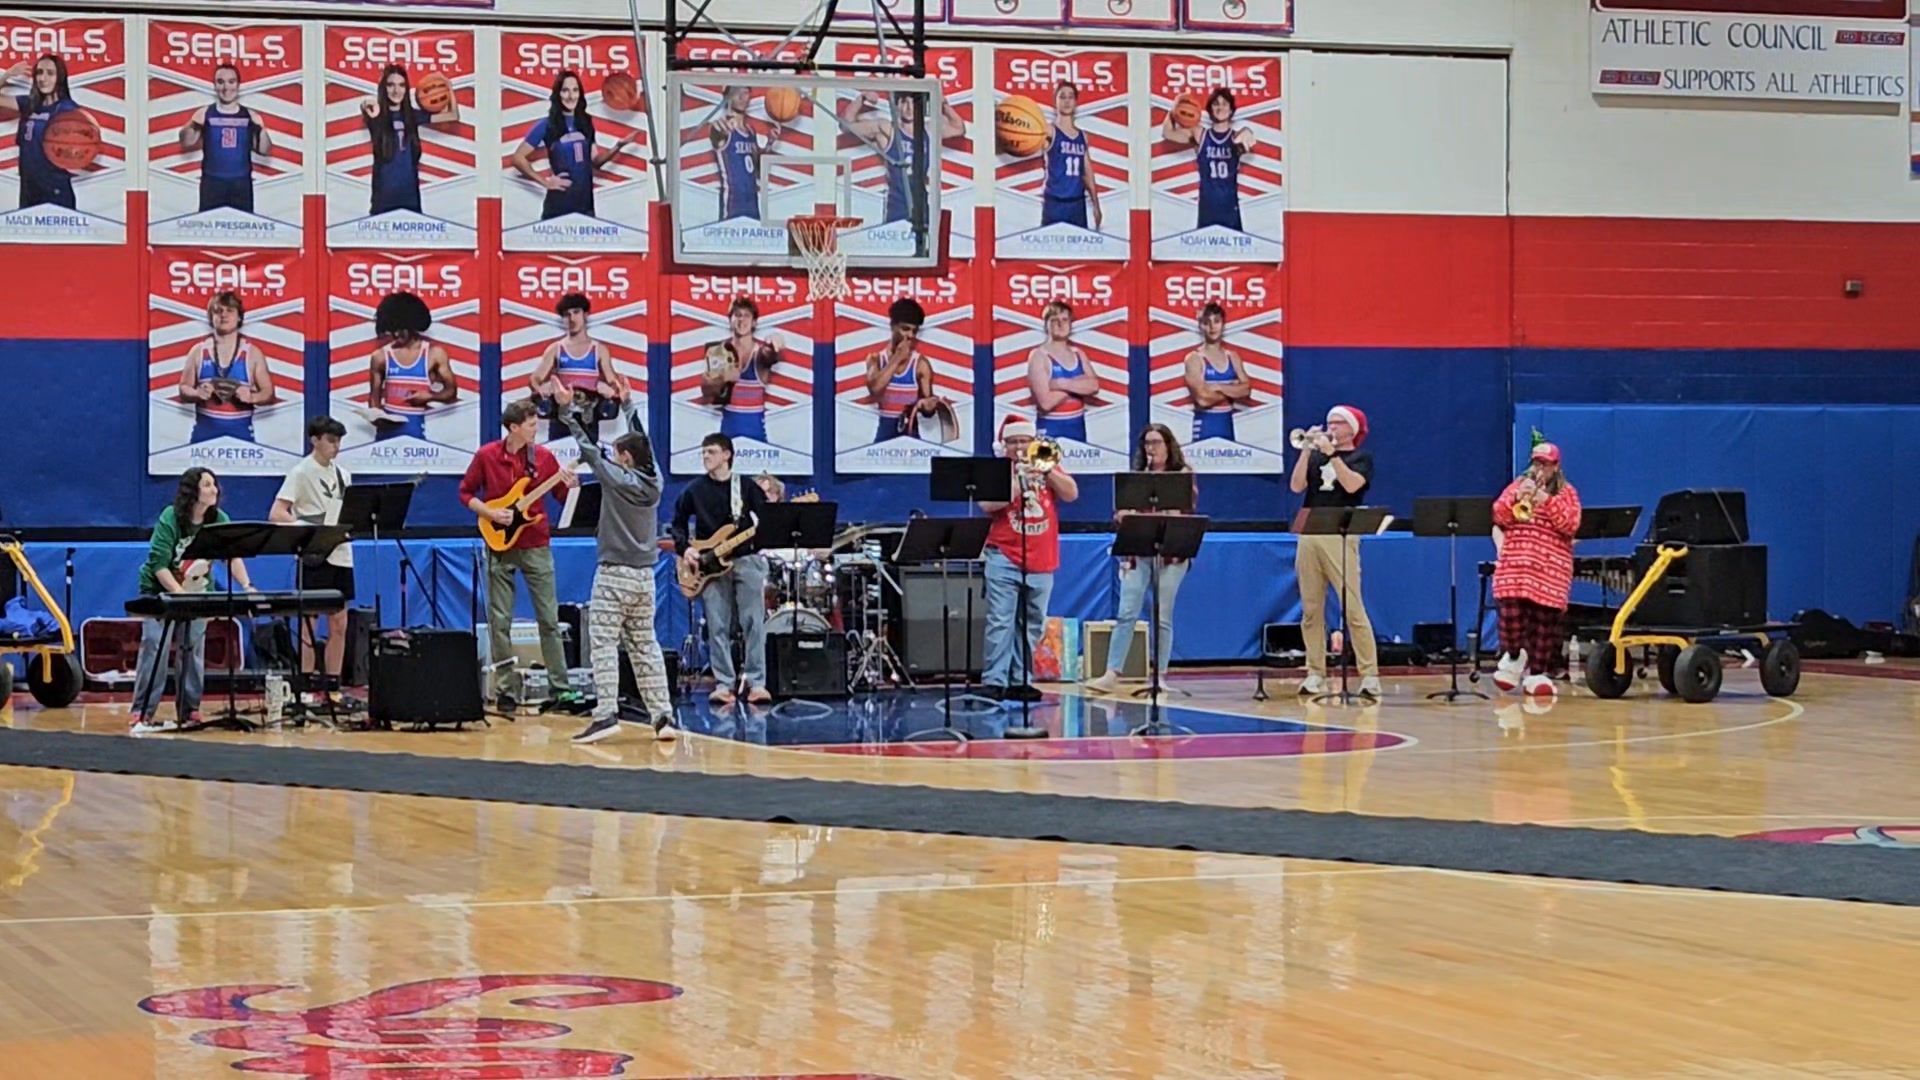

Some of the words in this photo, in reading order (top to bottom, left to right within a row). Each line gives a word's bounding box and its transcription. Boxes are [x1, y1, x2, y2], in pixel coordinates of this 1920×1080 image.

[1601, 18, 1711, 46] ATHLETIC
[1728, 22, 1828, 51] COUNCIL
[167, 31, 285, 60] SEALS
[343, 36, 458, 64] SEALS
[518, 43, 630, 70] SEALS
[1010, 59, 1113, 85] SEALS
[1165, 63, 1267, 89] SEALS
[1663, 69, 1756, 91] SUPPORTS
[1766, 72, 1799, 93] ALL
[1808, 74, 1905, 97] ATHLETICS
[1060, 141, 1085, 155] SEALS
[1205, 146, 1232, 159] SEALS
[744, 155, 754, 173] 0
[1065, 156, 1080, 176] 11
[1209, 160, 1229, 178] 10
[5, 215, 32, 225] MADI
[35, 216, 89, 226] MERRELL
[214, 221, 276, 231] PRESGRAVES
[357, 220, 390, 231] GRACE
[392, 221, 447, 232] MORRONE
[532, 225, 577, 235] MADALYN
[579, 226, 619, 236] BENNER
[703, 227, 739, 238] GRIFFIN
[741, 228, 784, 239] PARKER
[867, 230, 898, 241] CHASE
[1181, 235, 1208, 245] NOAH
[1209, 236, 1252, 246] WALTER
[168, 261, 287, 289] SEALS
[347, 263, 462, 289] SEALS
[517, 266, 630, 292] SEALS
[1009, 274, 1113, 299] SEALS
[1165, 276, 1266, 301] SEALS
[191, 447, 215, 458] JACK
[217, 448, 264, 459] PETERS
[370, 446, 398, 458] ALEX
[402, 447, 440, 458] SURUJ
[735, 449, 780, 459] ARPSTER
[866, 447, 908, 458] ANTHONY
[1203, 449, 1252, 459] HEIMBACH
